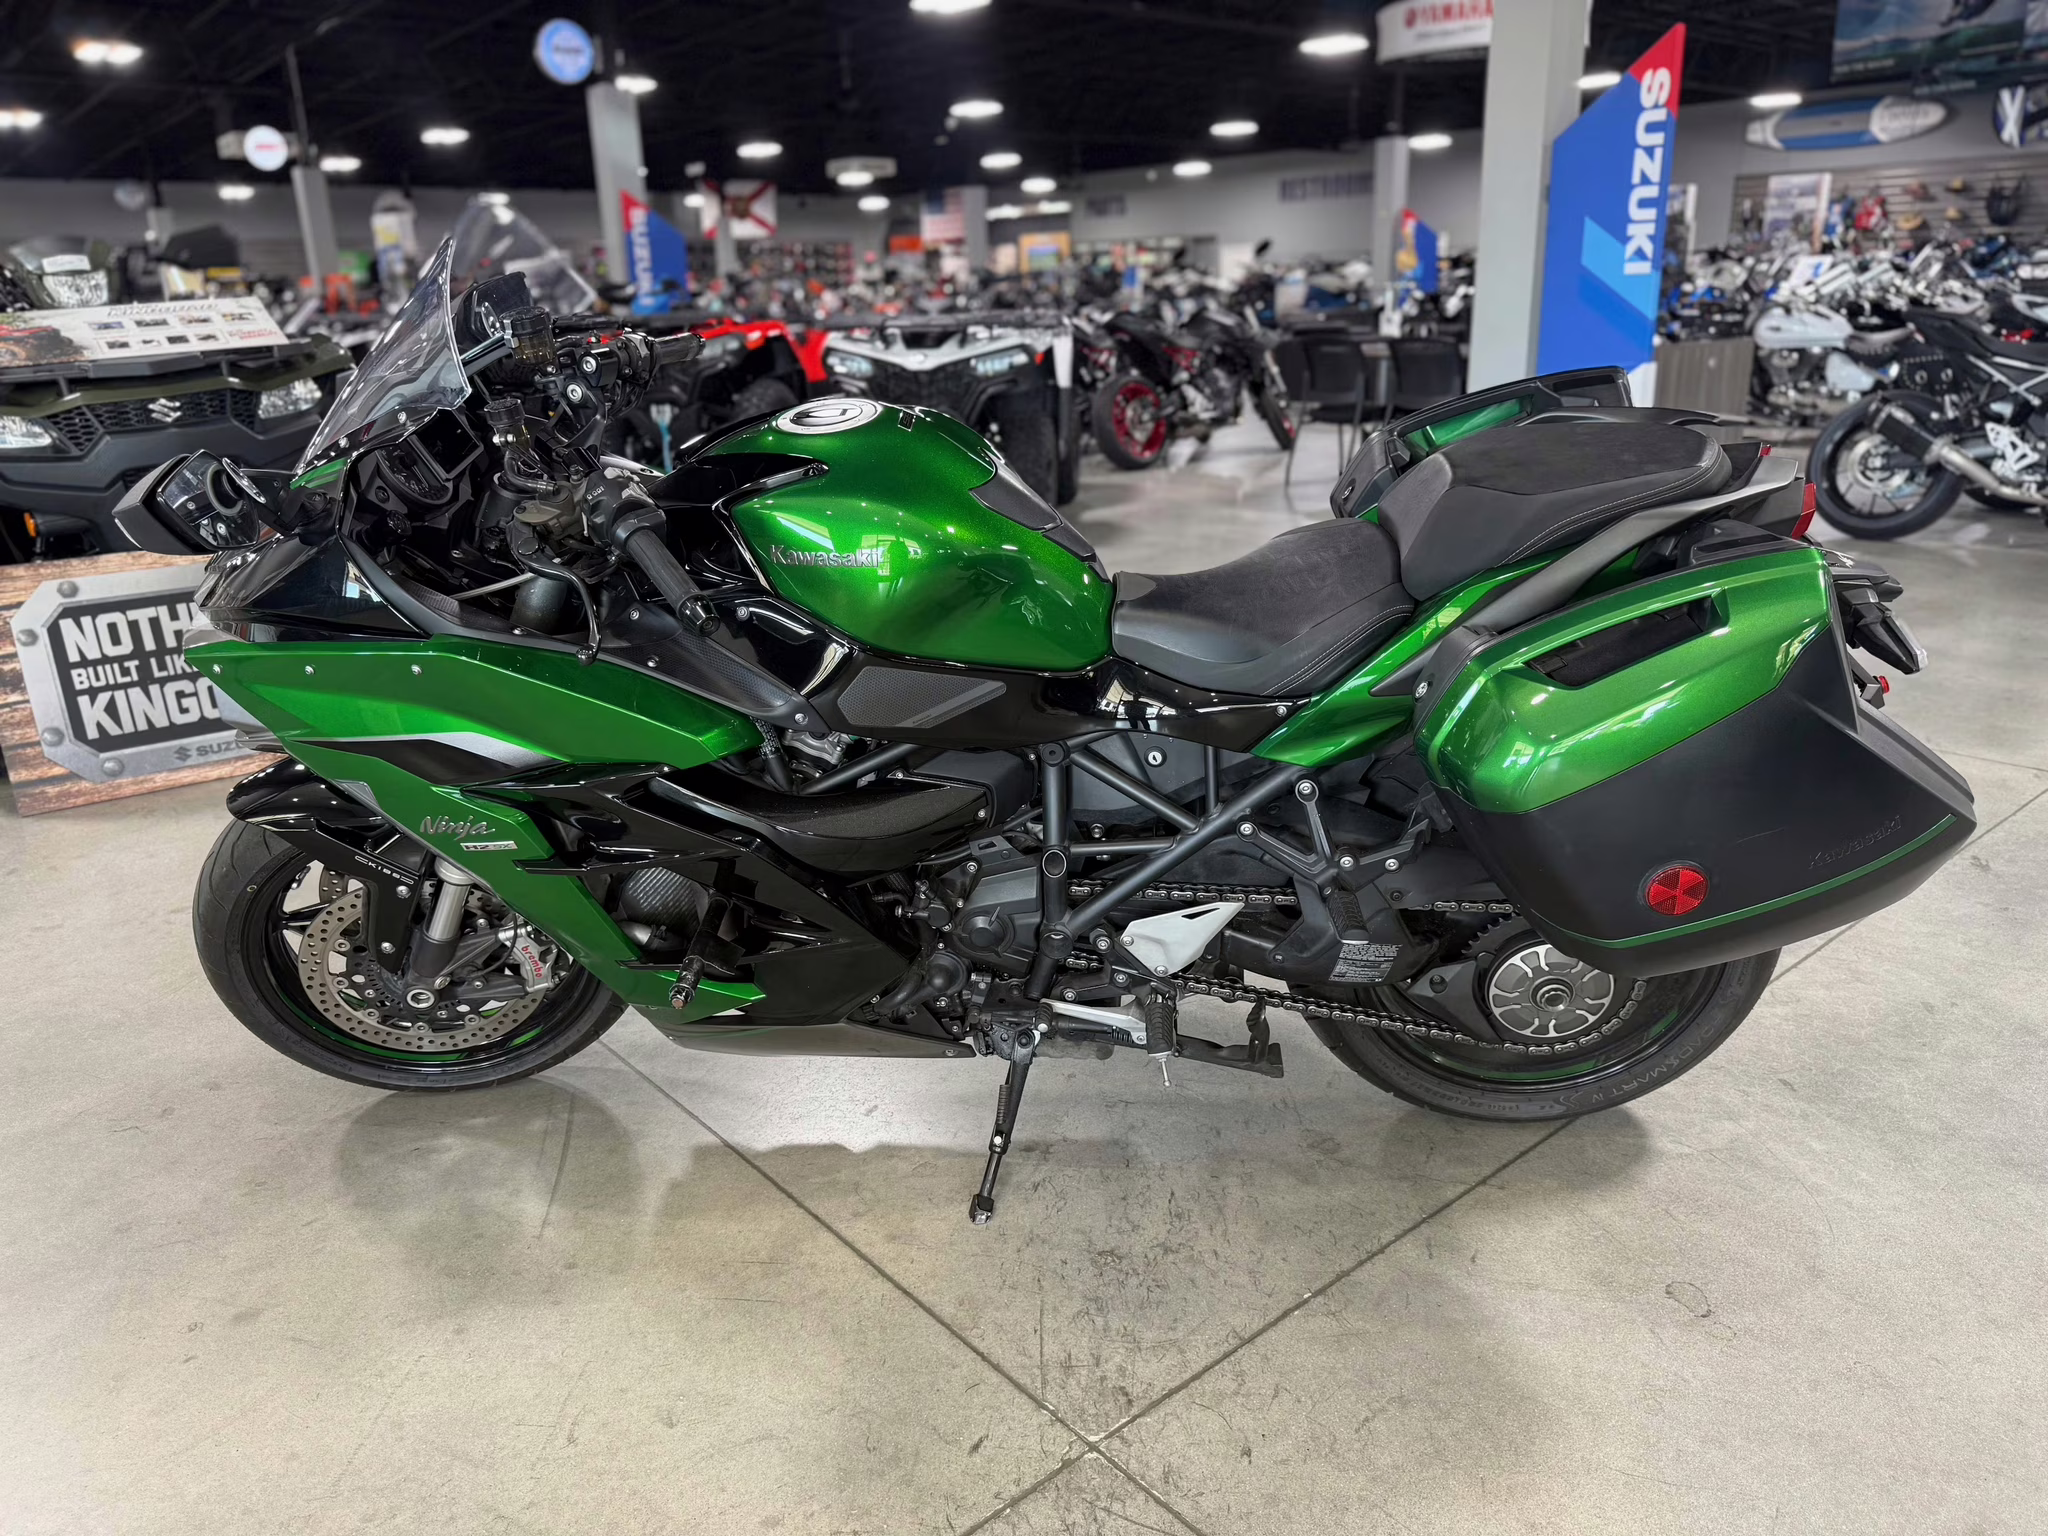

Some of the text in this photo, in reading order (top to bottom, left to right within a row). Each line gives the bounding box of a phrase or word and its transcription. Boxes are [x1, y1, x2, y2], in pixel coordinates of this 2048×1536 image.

[1623, 66, 1671, 276] SUZUKI
[769, 544, 880, 568] Kawasaki
[70, 653, 199, 691] BUILT LIK
[419, 815, 496, 841] Ninja
[1808, 815, 1902, 869] Kawasaki
[521, 943, 545, 979] brembo
